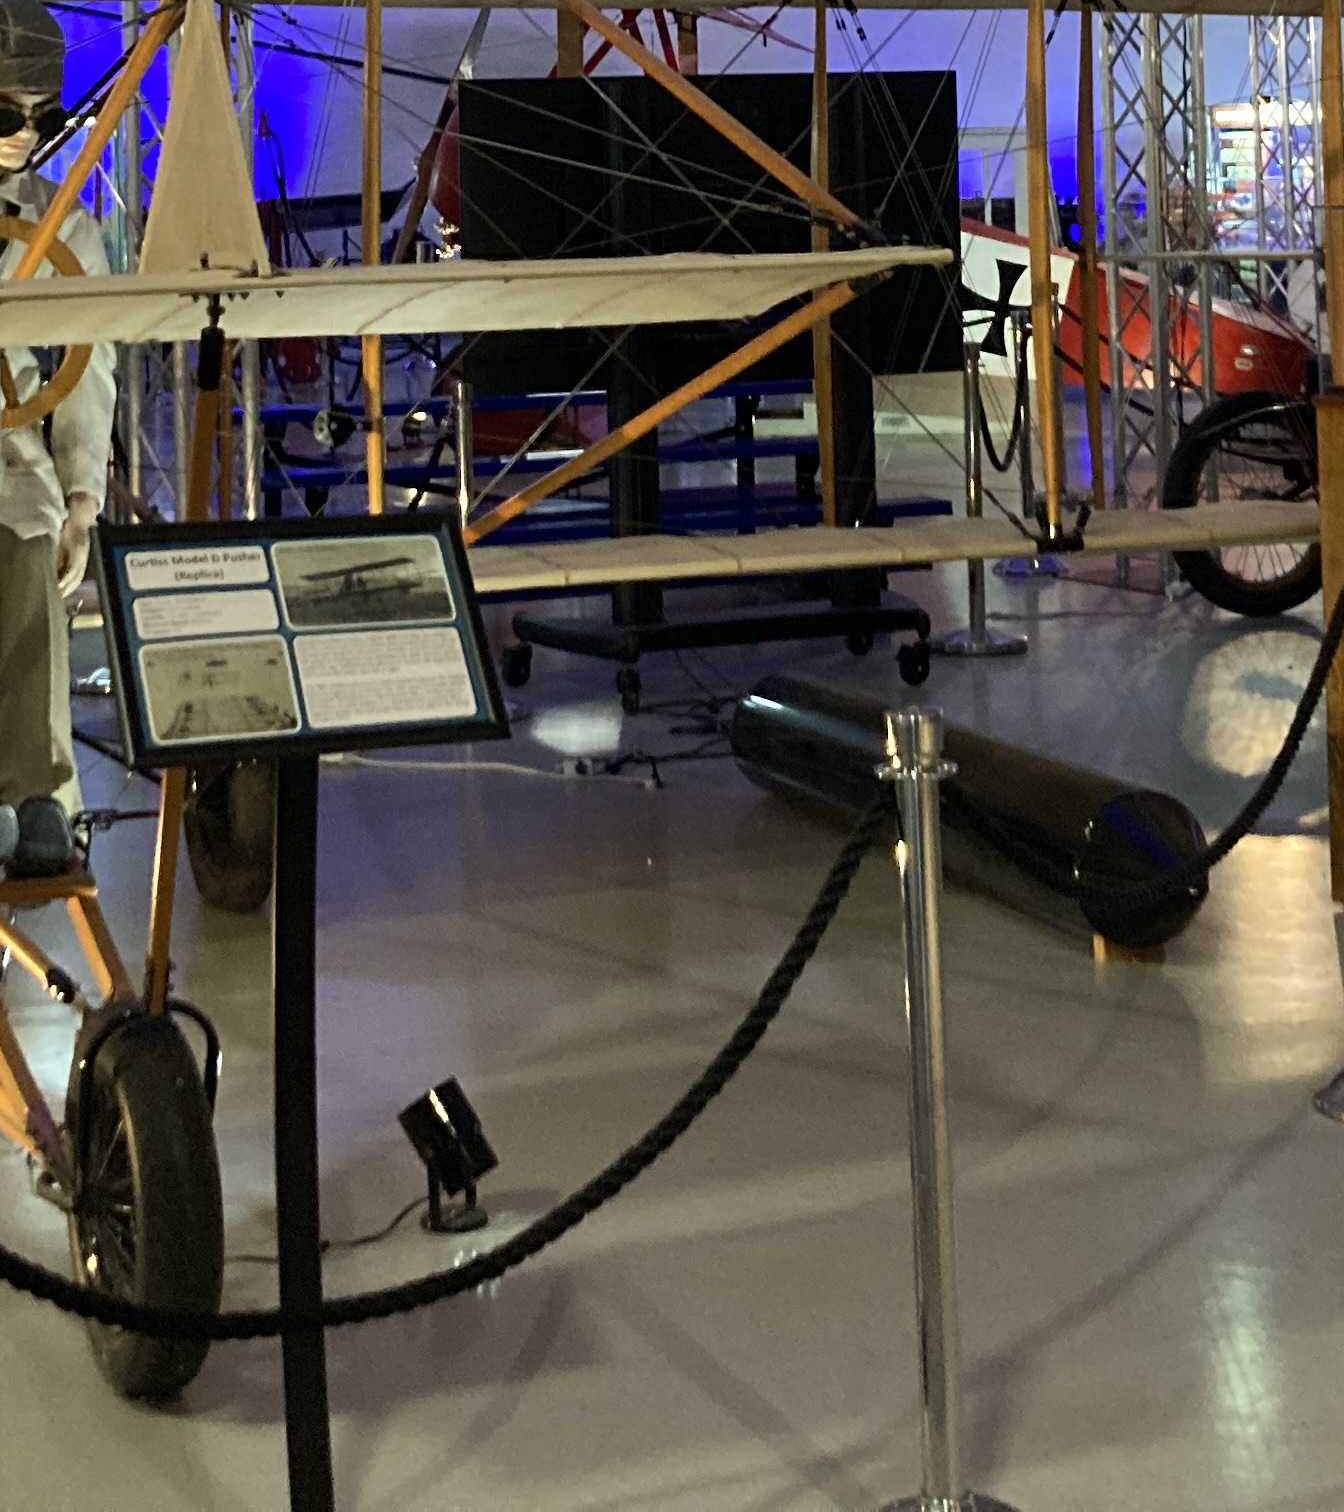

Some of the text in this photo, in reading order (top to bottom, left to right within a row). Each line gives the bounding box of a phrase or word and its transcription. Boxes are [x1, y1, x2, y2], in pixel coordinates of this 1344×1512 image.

[130, 556, 169, 569] Curtiss
[172, 553, 209, 566] Model
[223, 550, 262, 563] Pusher
